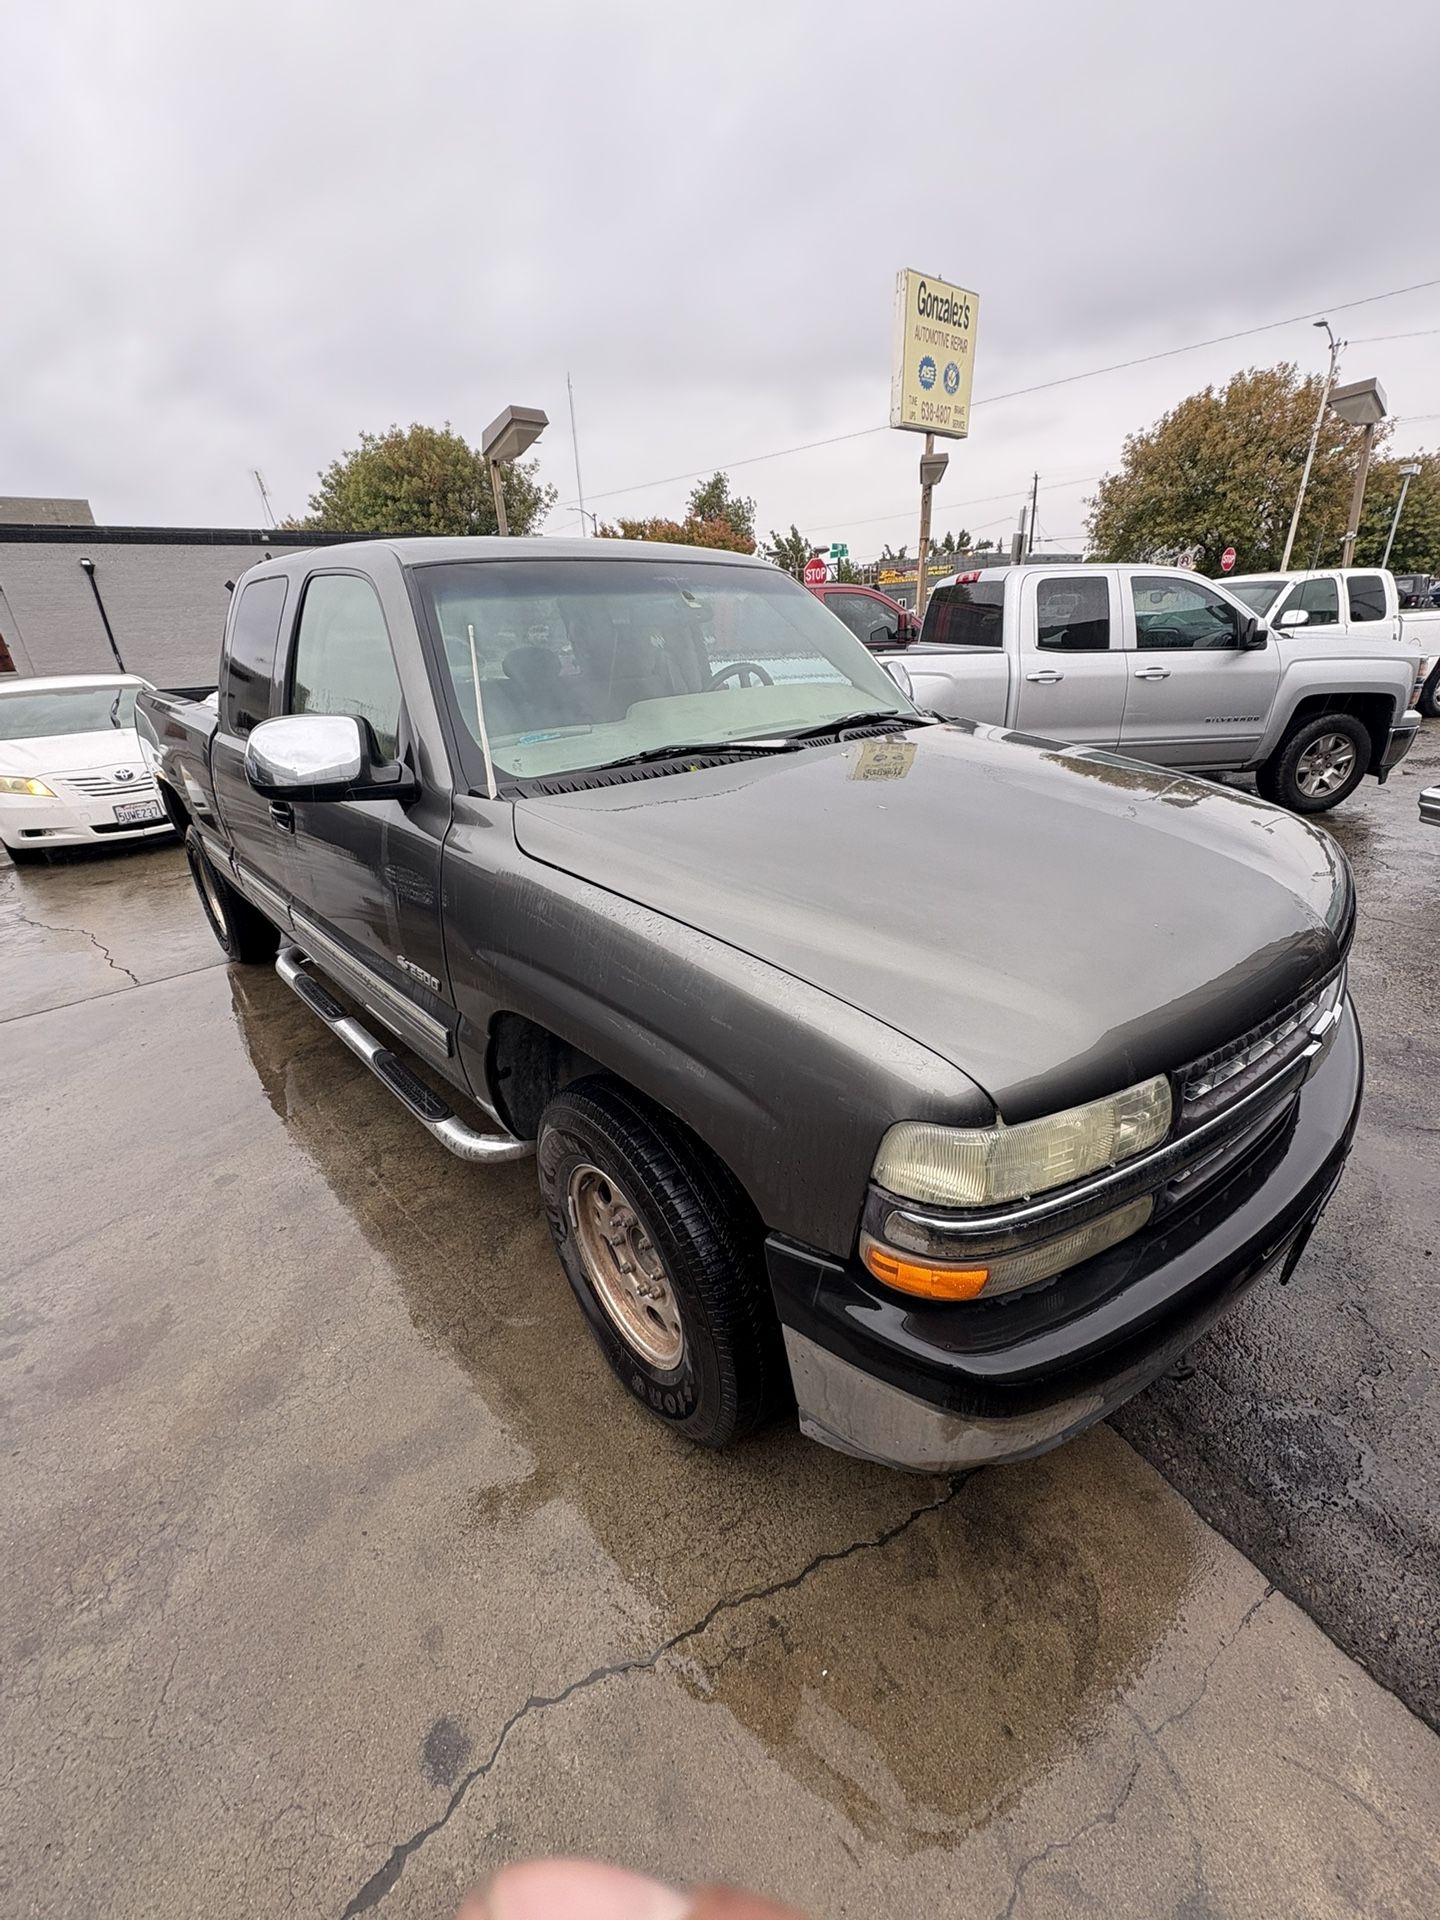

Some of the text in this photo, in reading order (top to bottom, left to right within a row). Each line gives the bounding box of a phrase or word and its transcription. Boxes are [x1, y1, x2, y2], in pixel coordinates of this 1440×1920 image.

[917, 280, 970, 330] Gonzalez's
[914, 325, 968, 354] AUTOMOTIVE REPAIR
[920, 365, 935, 379] ASE
[921, 400, 951, 425] 638-4807
[1222, 554, 1235, 564] STOP
[805, 567, 826, 581] STOP
[1204, 715, 1260, 724] SILVERADO
[118, 806, 158, 822] 5UWE237
